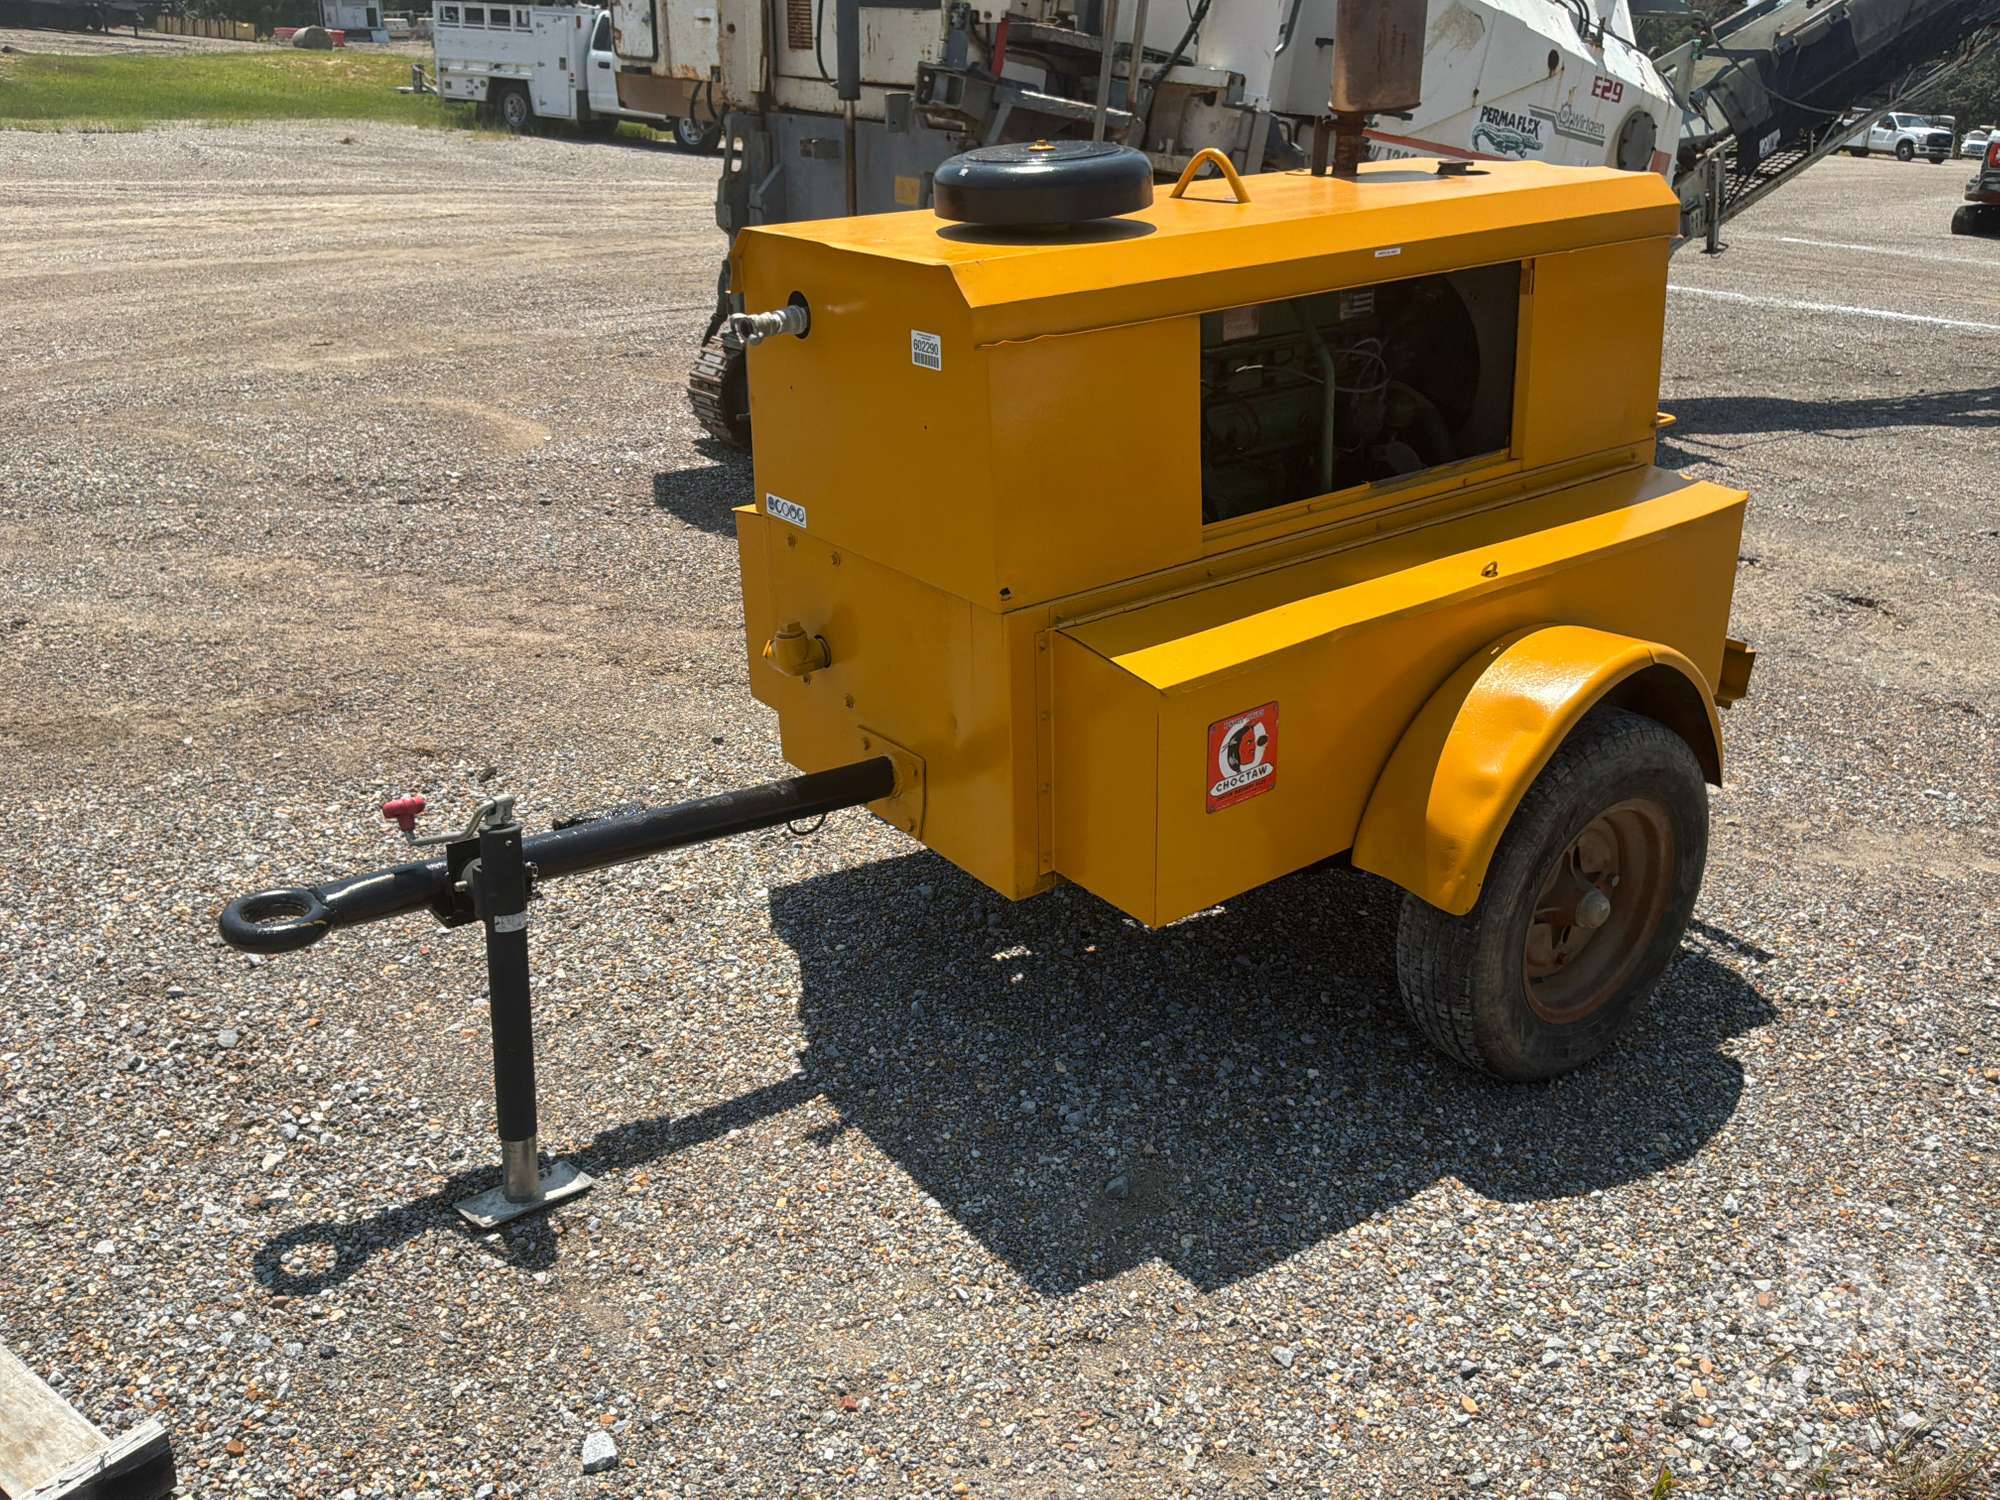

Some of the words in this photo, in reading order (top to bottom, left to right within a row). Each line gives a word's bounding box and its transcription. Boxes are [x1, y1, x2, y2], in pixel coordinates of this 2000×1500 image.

[1592, 75, 1624, 104] E29
[913, 338, 939, 356] 602290
[1215, 765, 1268, 792] CHOCTAW
